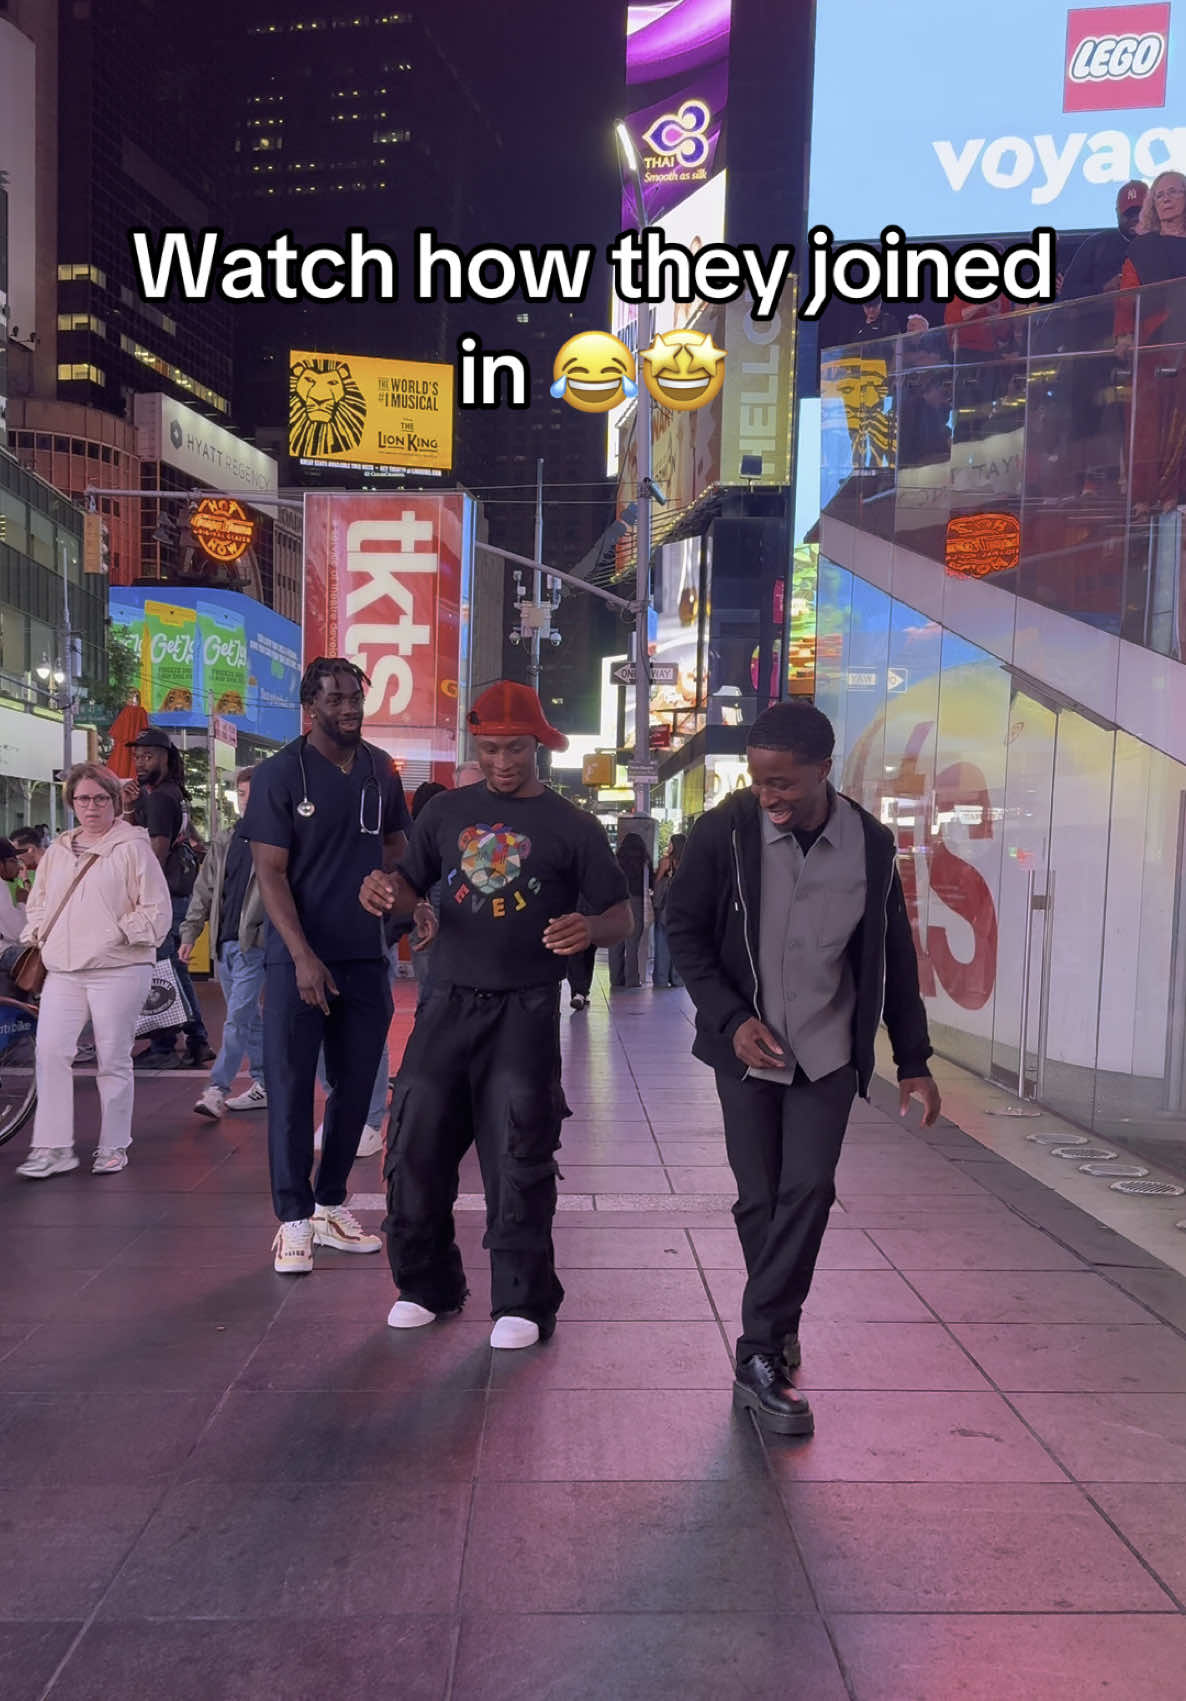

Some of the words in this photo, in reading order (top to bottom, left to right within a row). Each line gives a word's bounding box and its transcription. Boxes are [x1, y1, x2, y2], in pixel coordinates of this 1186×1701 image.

[1069, 32, 1164, 83] LEGO
[644, 156, 675, 168] THAI
[644, 171, 679, 182] Smooth
[391, 378, 438, 396] WORLD'S
[391, 394, 439, 411] MUSICAL
[401, 422, 414, 431] THE
[187, 433, 223, 467] HYATT
[207, 538, 238, 555] NOW
[345, 511, 438, 717] tkts
